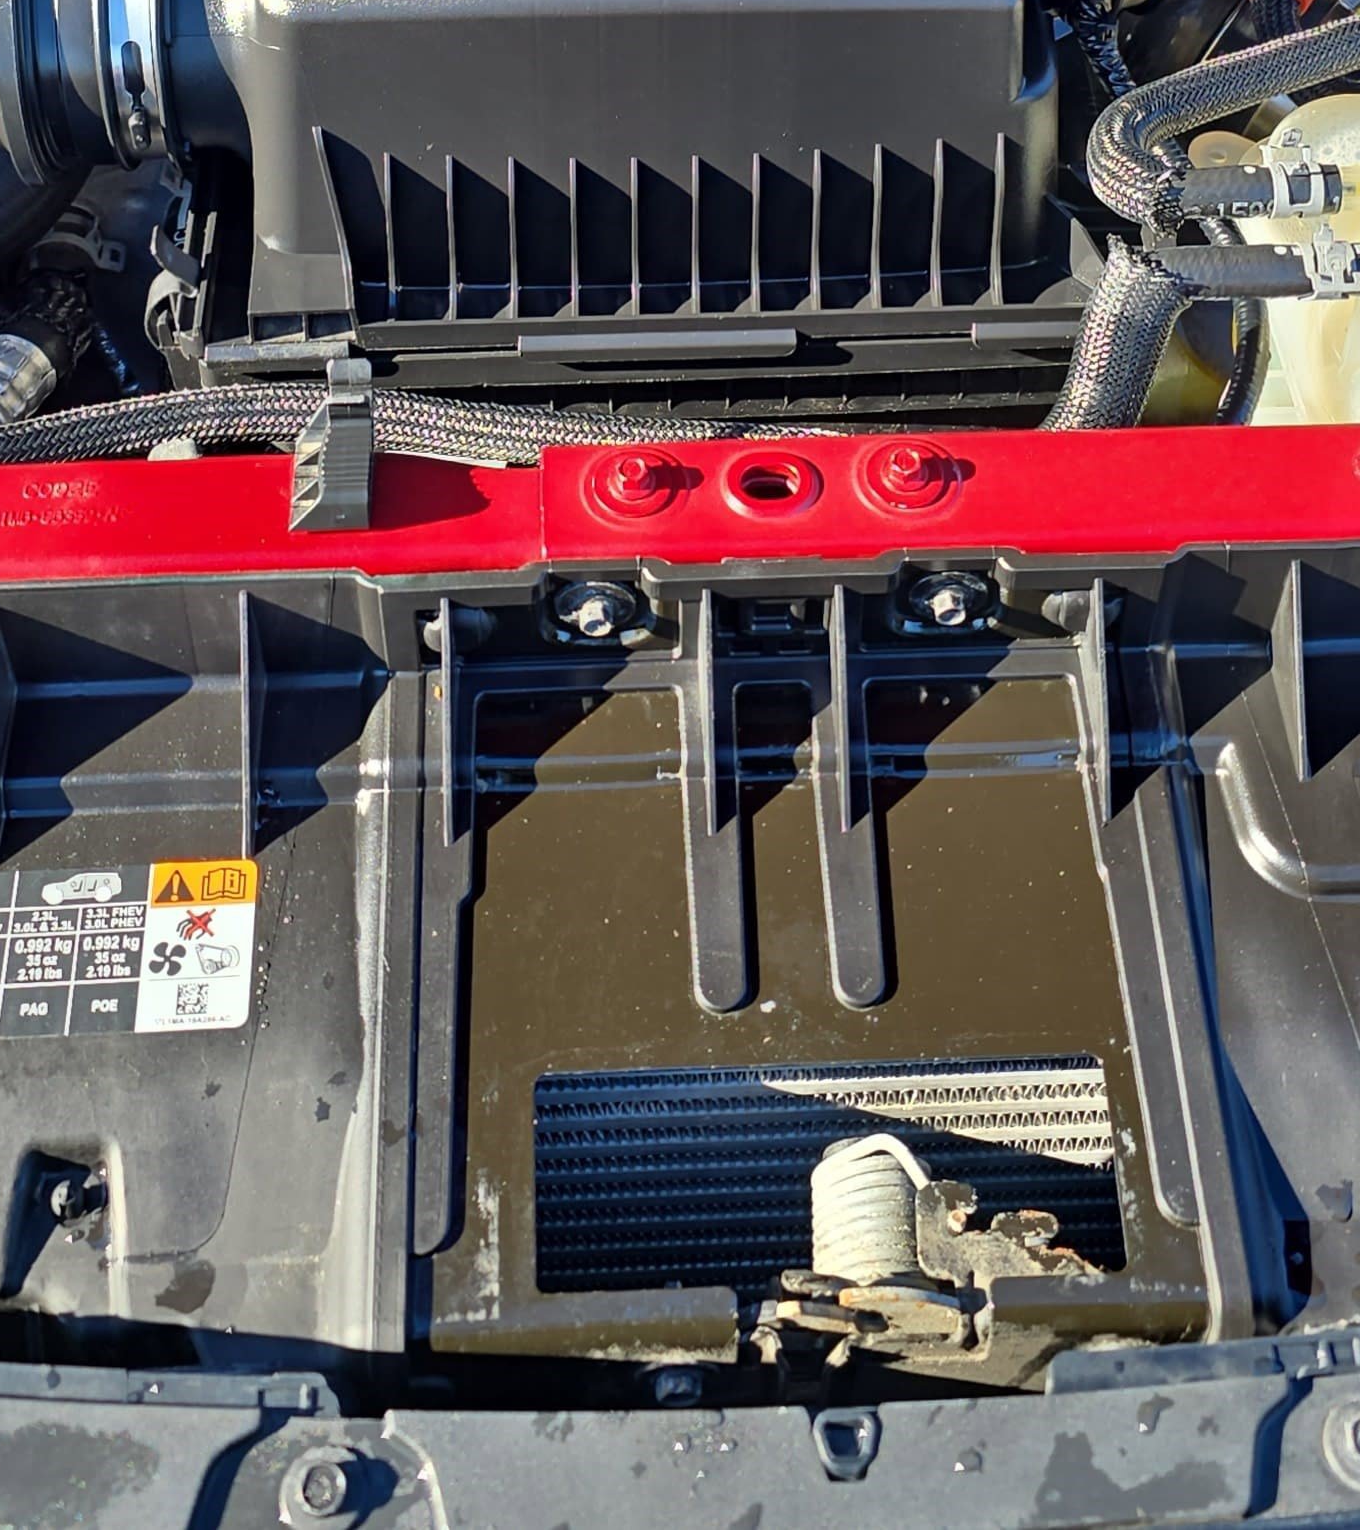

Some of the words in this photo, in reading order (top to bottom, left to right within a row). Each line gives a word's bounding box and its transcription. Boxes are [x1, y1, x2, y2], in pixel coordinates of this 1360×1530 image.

[86, 908, 110, 919] 3.3L
[112, 906, 144, 917] FHEV
[13, 922, 38, 933] 3.0L
[51, 921, 75, 931] 3.3L
[85, 919, 109, 930] 3.0L
[110, 917, 144, 928] PHEV
[14, 938, 53, 954] 0.992
[54, 937, 73, 954] kg
[83, 935, 120, 952] 0.992
[122, 934, 141, 952] kg
[26, 954, 42, 967] 35
[43, 955, 59, 966] oz
[94, 951, 110, 964] 35
[111, 952, 127, 963] oz
[43, 967, 63, 980] lbs
[85, 965, 111, 979] 2.19
[112, 964, 132, 977] lbs
[19, 1002, 49, 1017] PAG
[91, 999, 119, 1013] POE
